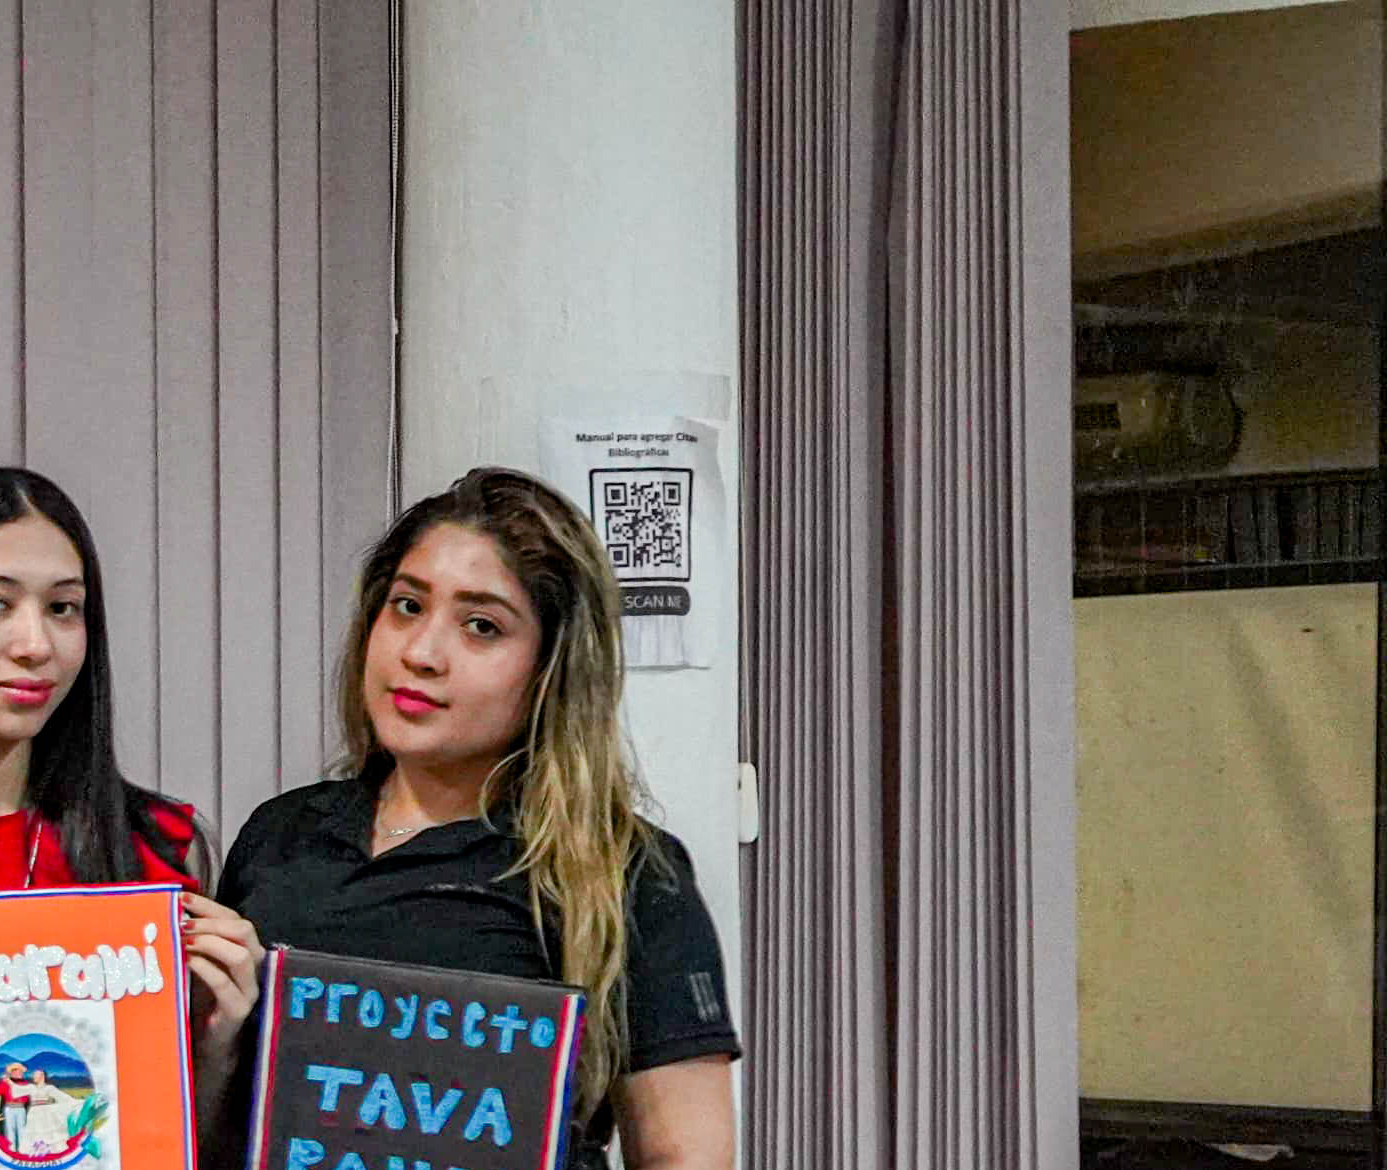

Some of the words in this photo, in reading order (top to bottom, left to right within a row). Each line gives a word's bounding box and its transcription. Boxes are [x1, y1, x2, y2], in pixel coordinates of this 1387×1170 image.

[575, 432, 614, 442] Manual
[616, 434, 638, 443] para
[640, 433, 674, 443] agregar
[624, 594, 665, 609] SCAN
[305, 1064, 513, 1147] TAVA
